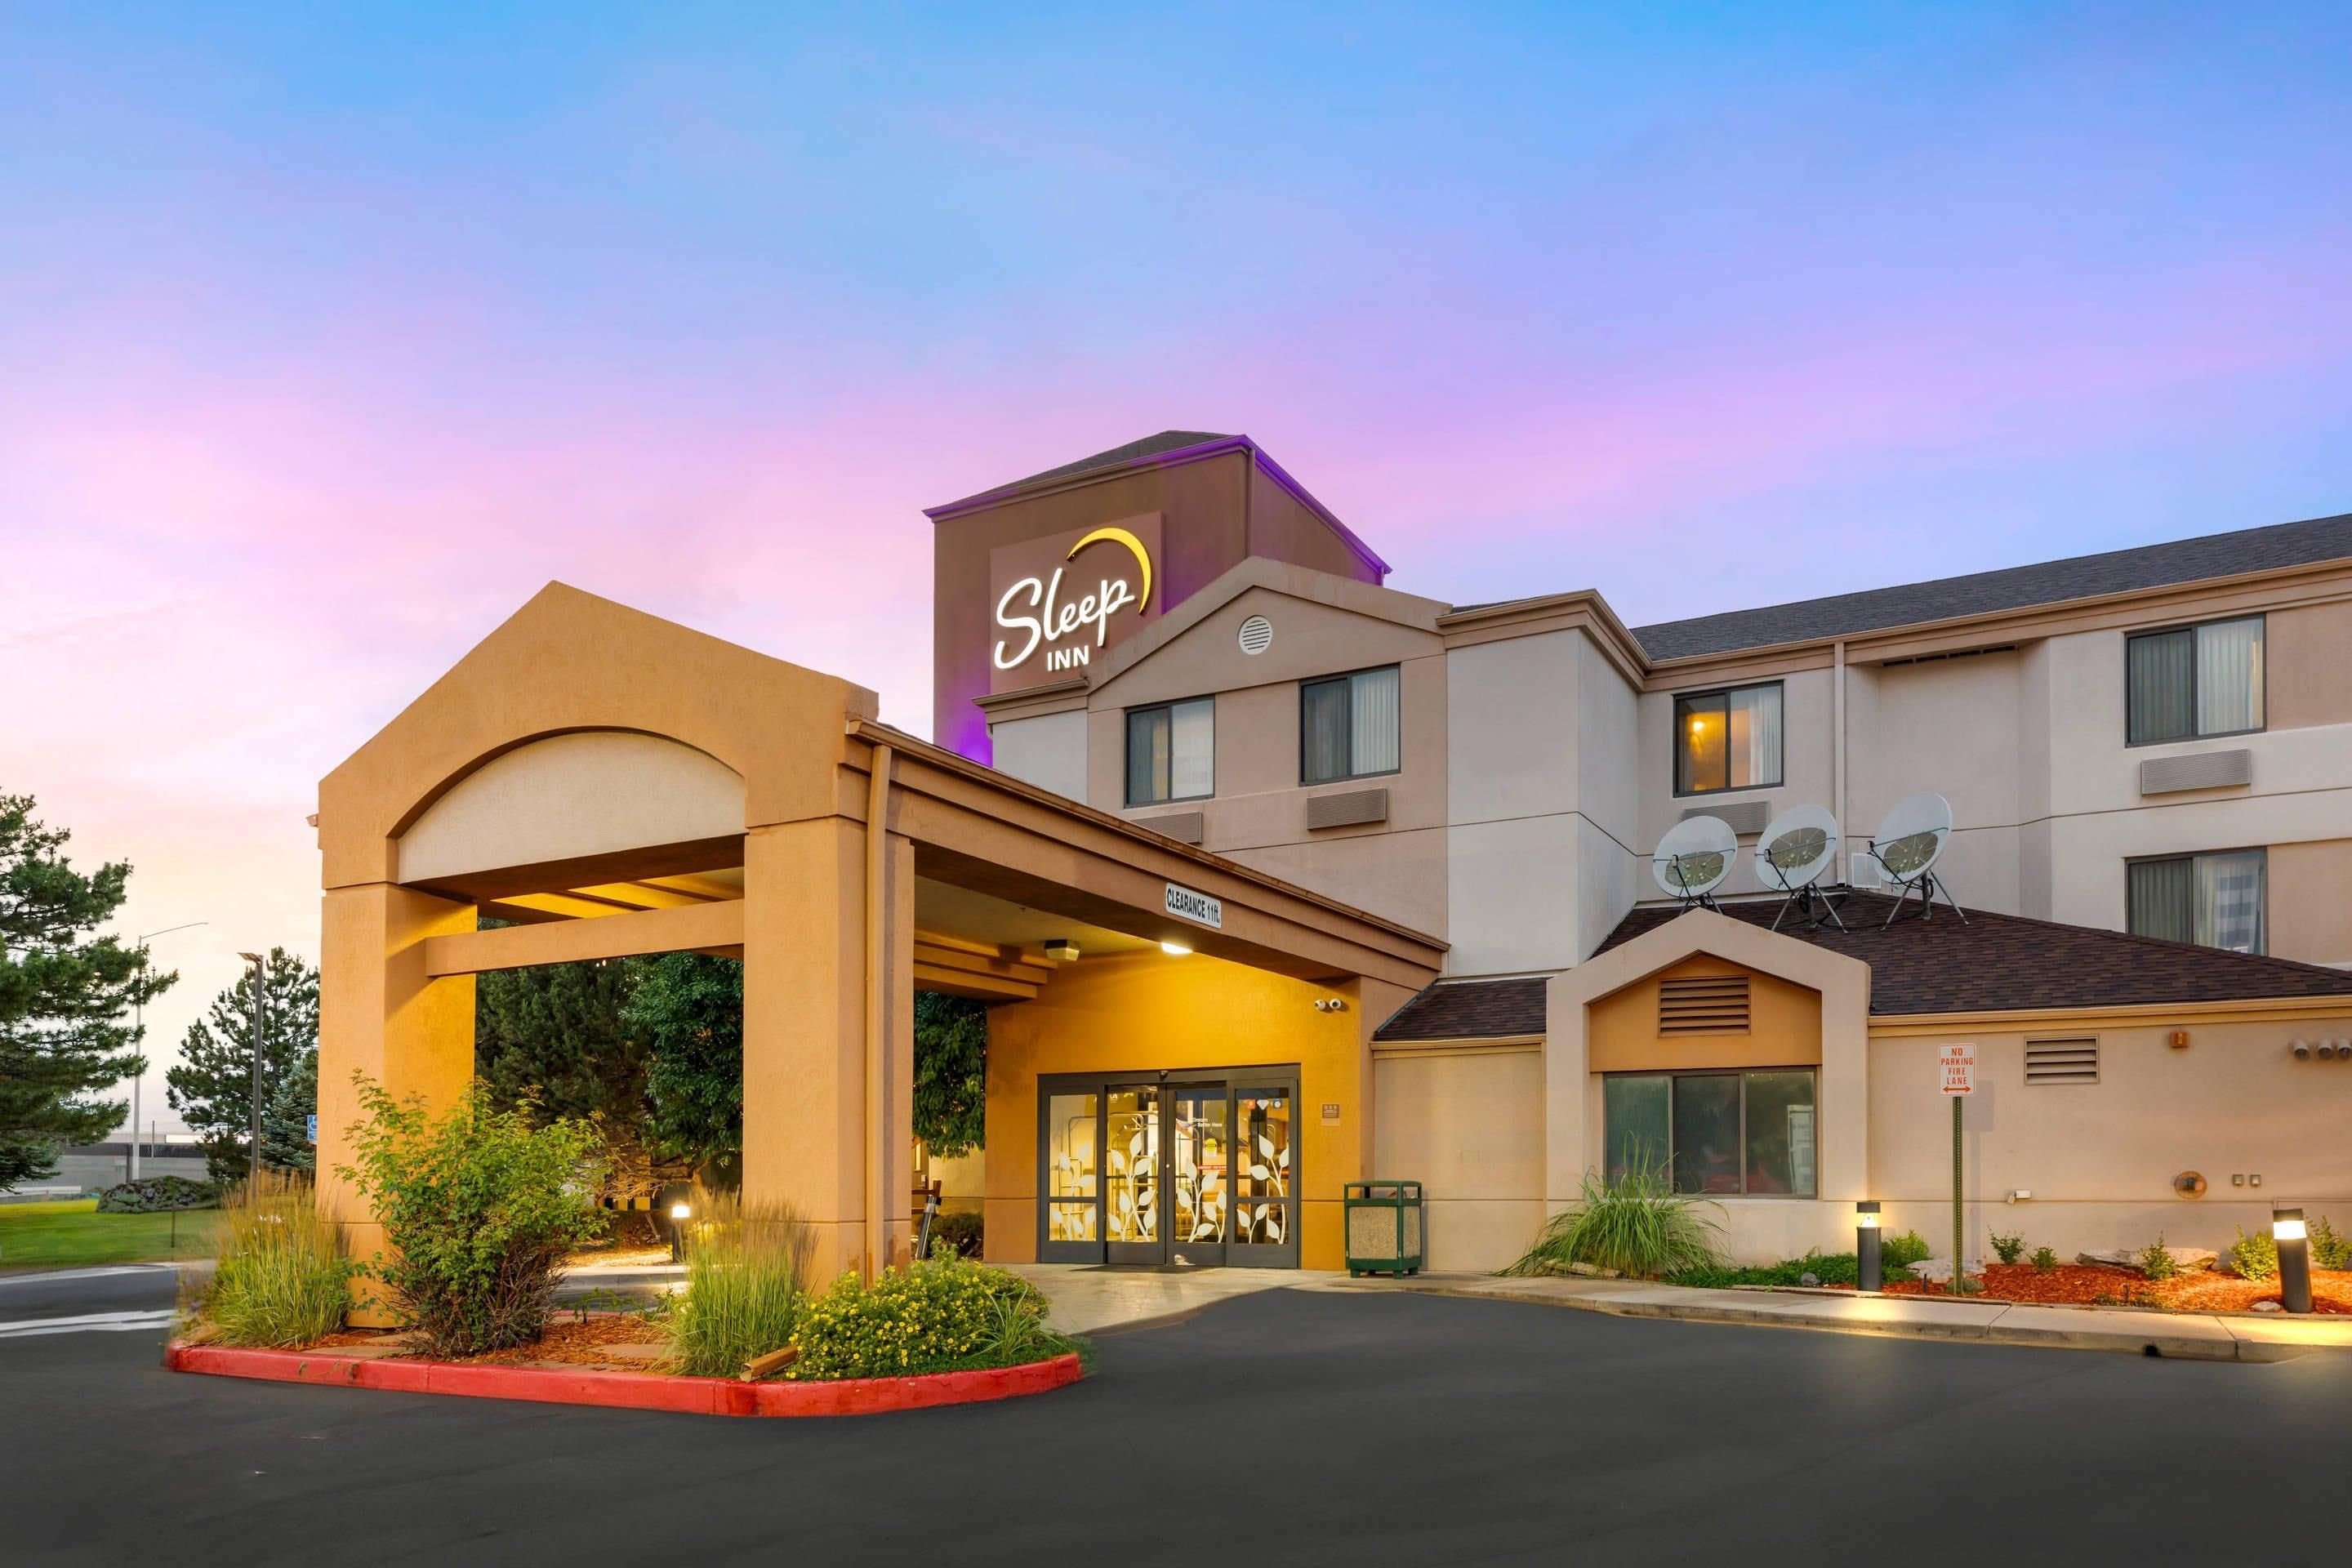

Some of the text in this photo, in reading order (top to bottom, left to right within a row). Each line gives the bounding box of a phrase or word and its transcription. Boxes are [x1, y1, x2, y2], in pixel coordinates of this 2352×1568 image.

[994, 568, 1135, 669] Sleep
[1047, 645, 1089, 671] INN
[1166, 888, 1205, 919] CLEARANCE
[1951, 1047, 1963, 1056] NO
[1940, 1058, 1973, 1066] PARKING
[1948, 1067, 1966, 1076] FIRE
[1946, 1076, 1967, 1085] LANE
